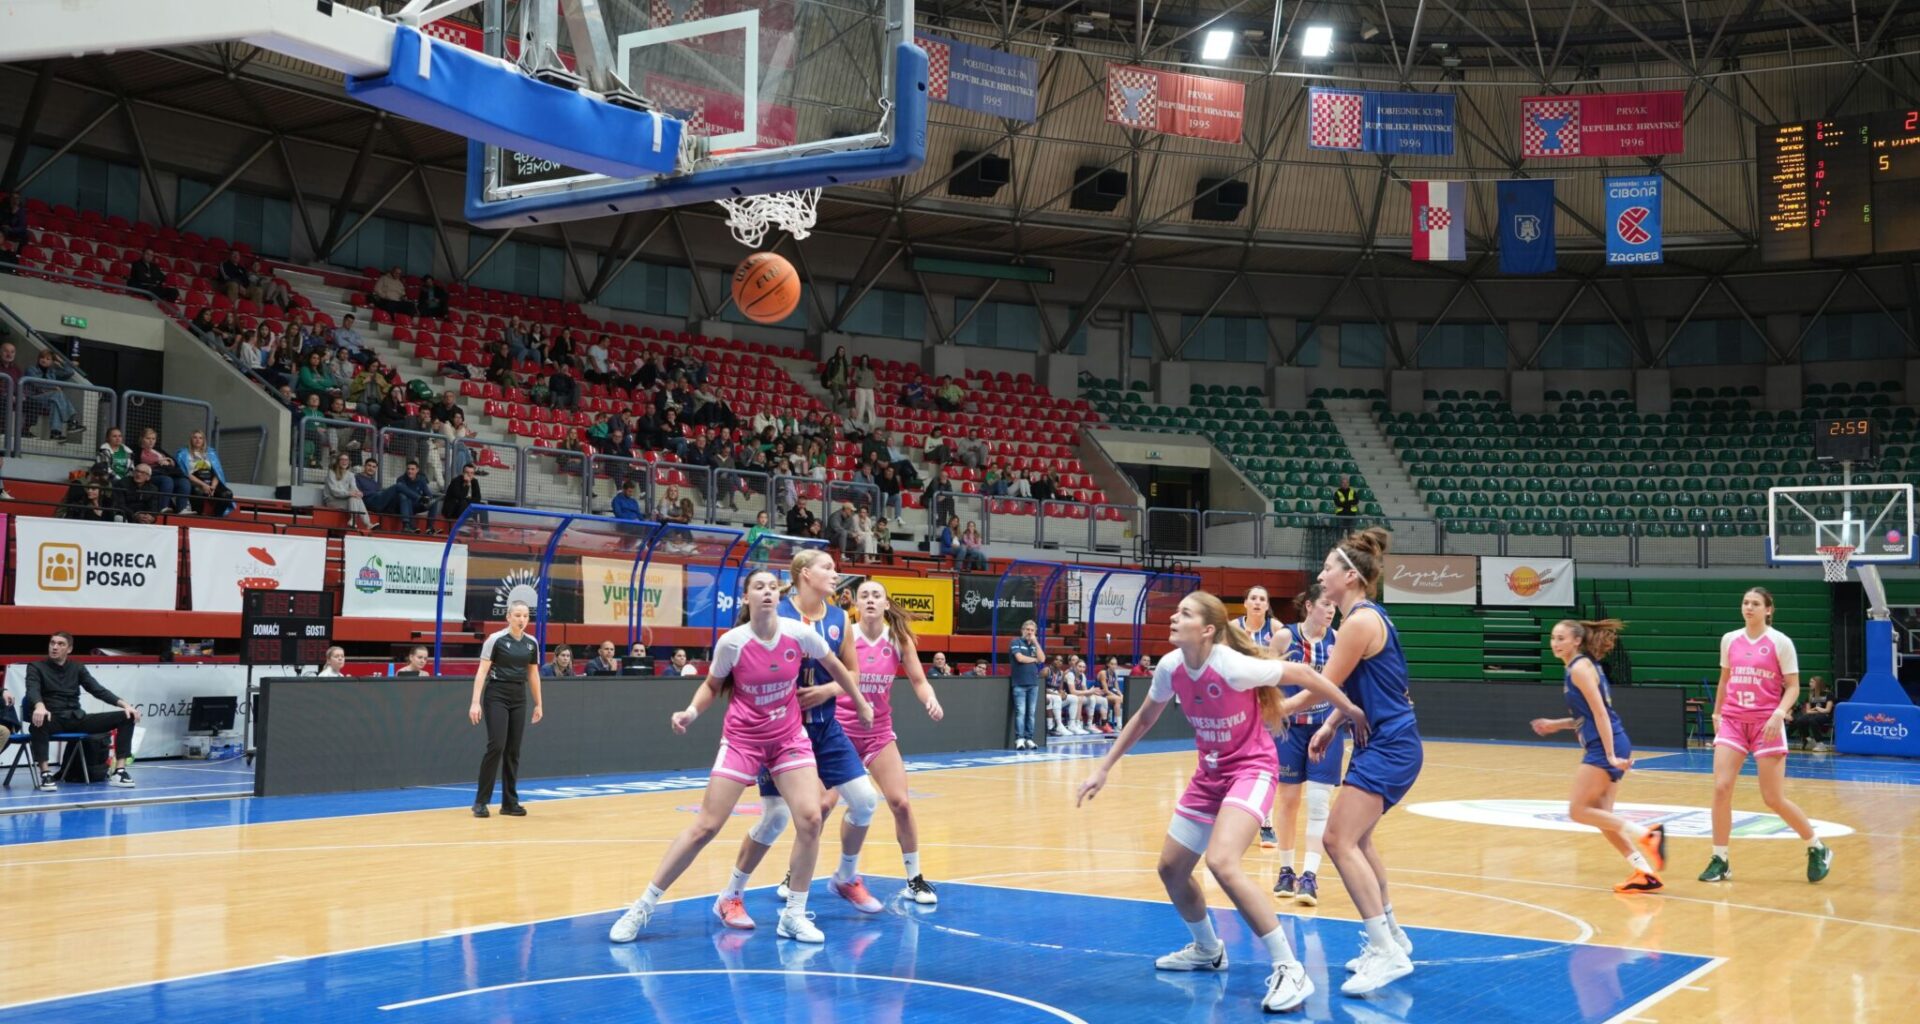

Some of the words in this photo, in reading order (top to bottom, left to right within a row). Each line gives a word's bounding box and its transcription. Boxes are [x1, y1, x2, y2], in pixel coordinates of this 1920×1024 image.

[951, 71, 997, 89] REPUBLIKE
[983, 95, 1002, 108] 1995
[1187, 89, 1215, 101] PRVAK
[1158, 100, 1202, 113] REPUBLIKE
[1204, 108, 1242, 119] HRVATSKE
[1423, 107, 1445, 117] KUPA
[1616, 106, 1648, 116] PRVAK
[1189, 119, 1211, 129] 1995
[1365, 121, 1411, 132] REPUBLIKE
[1412, 123, 1453, 133] HRVATSKE
[1581, 123, 1634, 133] REPUBLIKE
[1636, 120, 1681, 131] HRVATSKE
[1817, 131, 1824, 140] 6
[1400, 138, 1422, 148] 1996
[1620, 137, 1645, 148] 1996
[1879, 154, 1890, 171] 5
[1815, 170, 1825, 179] 10
[1610, 186, 1657, 198] CIBONA
[1610, 251, 1660, 263] ZAGREB
[1829, 420, 1868, 436] 2:59
[86, 551, 157, 569] HORECA
[86, 570, 146, 588] POSAO
[385, 561, 421, 584] TREŠNJEVKA
[422, 566, 442, 585] DINAM
[893, 597, 931, 610] SIMPAK
[613, 601, 656, 621] pia
[253, 621, 280, 636] DOMAĆI
[305, 625, 326, 637] GOSTI
[1736, 690, 1757, 708] 12
[147, 699, 194, 718] DRAŽE
[1850, 720, 1909, 738] Zagreb
